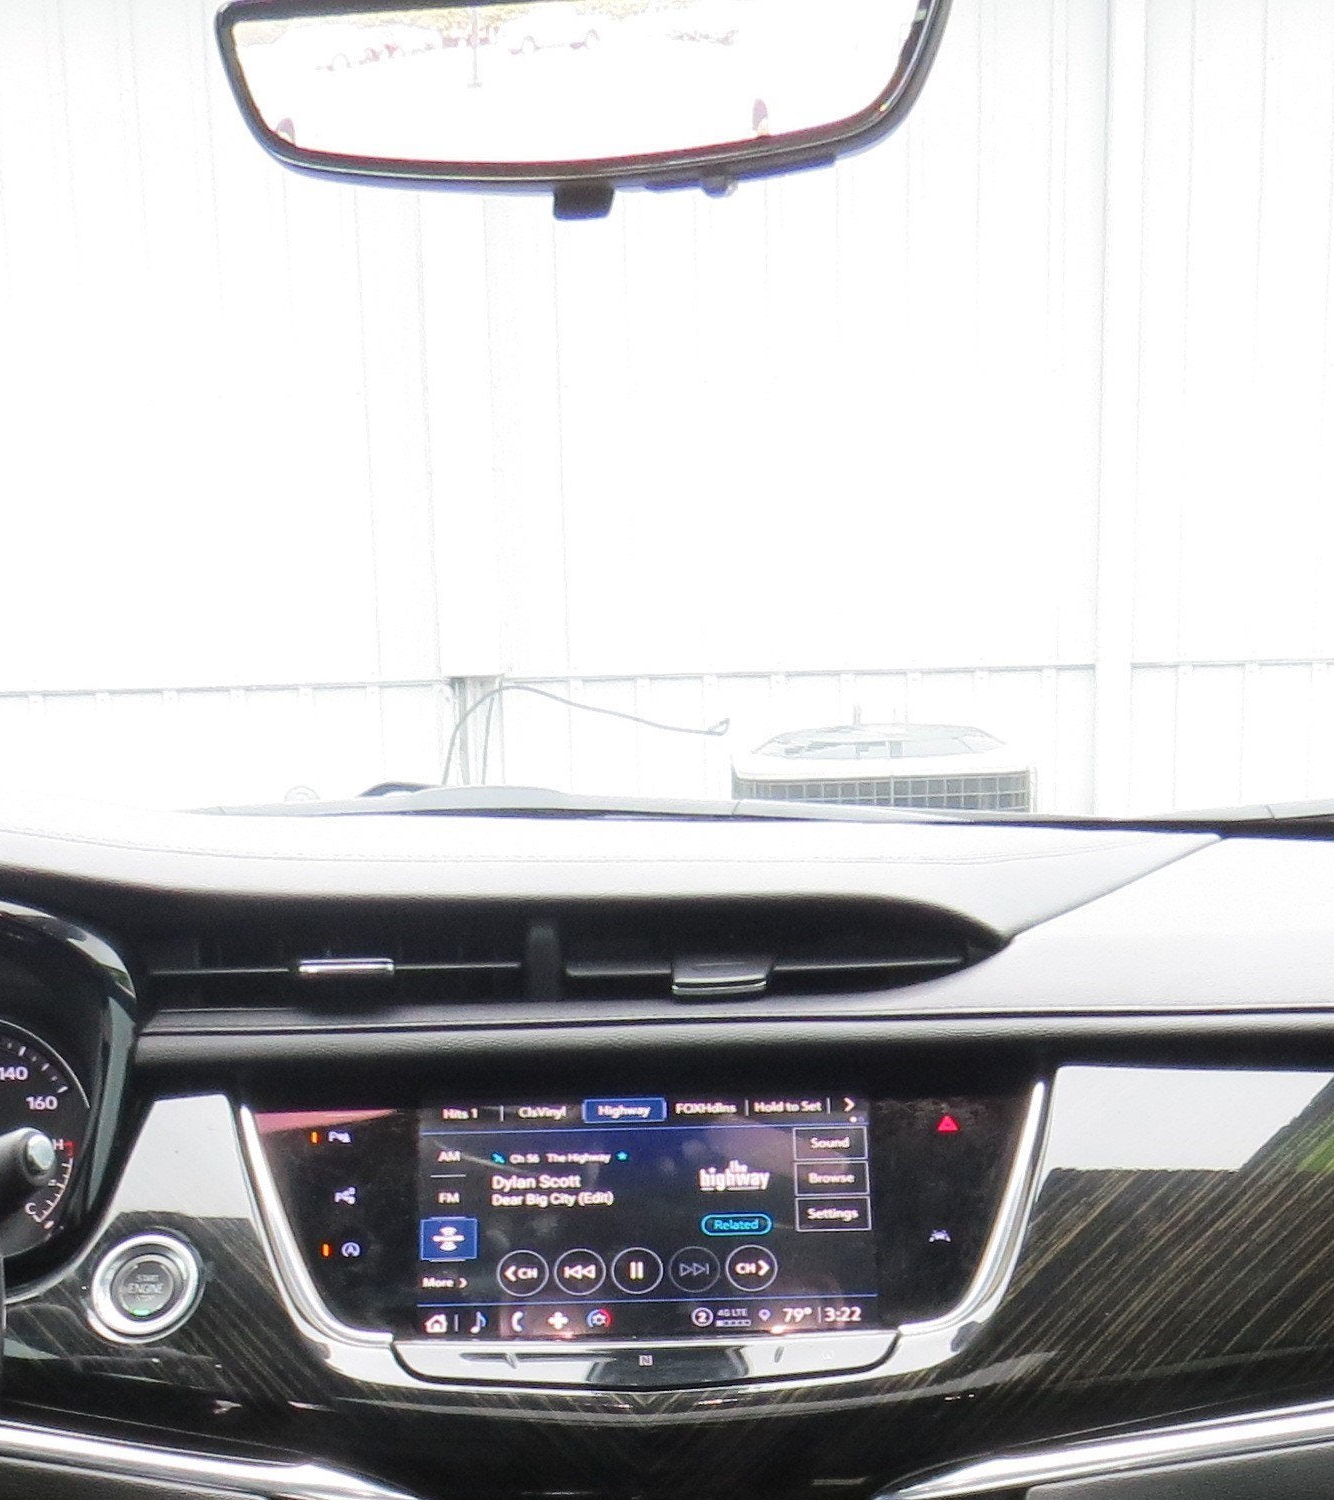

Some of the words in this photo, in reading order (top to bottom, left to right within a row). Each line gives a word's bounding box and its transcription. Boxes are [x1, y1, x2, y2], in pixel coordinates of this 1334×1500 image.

[25, 1096, 58, 1110] 160
[753, 1100, 784, 1113] Hold
[785, 1101, 800, 1112] to
[801, 1100, 822, 1112] Set
[442, 1108, 469, 1120] Hits
[471, 1108, 478, 1119] 1
[597, 1105, 652, 1119] Highway
[809, 1136, 851, 1149] Sound
[437, 1150, 461, 1162] AM
[546, 1153, 566, 1164] The
[568, 1152, 612, 1164] Highway
[729, 1159, 748, 1173] the
[491, 1175, 536, 1192] Dylan
[539, 1174, 582, 1189] Scott
[699, 1167, 771, 1192] highway
[808, 1172, 855, 1184] Browse
[438, 1192, 460, 1204] FM
[491, 1193, 524, 1207] Dear
[525, 1193, 549, 1208] Big
[550, 1192, 577, 1207] City
[578, 1190, 614, 1206] (Edit)
[24, 1202, 36, 1215] C
[807, 1207, 859, 1222] Settings
[713, 1218, 760, 1231] Related
[517, 1267, 538, 1280] CH
[735, 1262, 756, 1275] CH
[422, 1277, 454, 1289] More
[717, 1308, 730, 1317] 4G
[732, 1308, 748, 1317] LTE
[782, 1306, 813, 1322] 79°
[824, 1306, 862, 1322] 3:22
